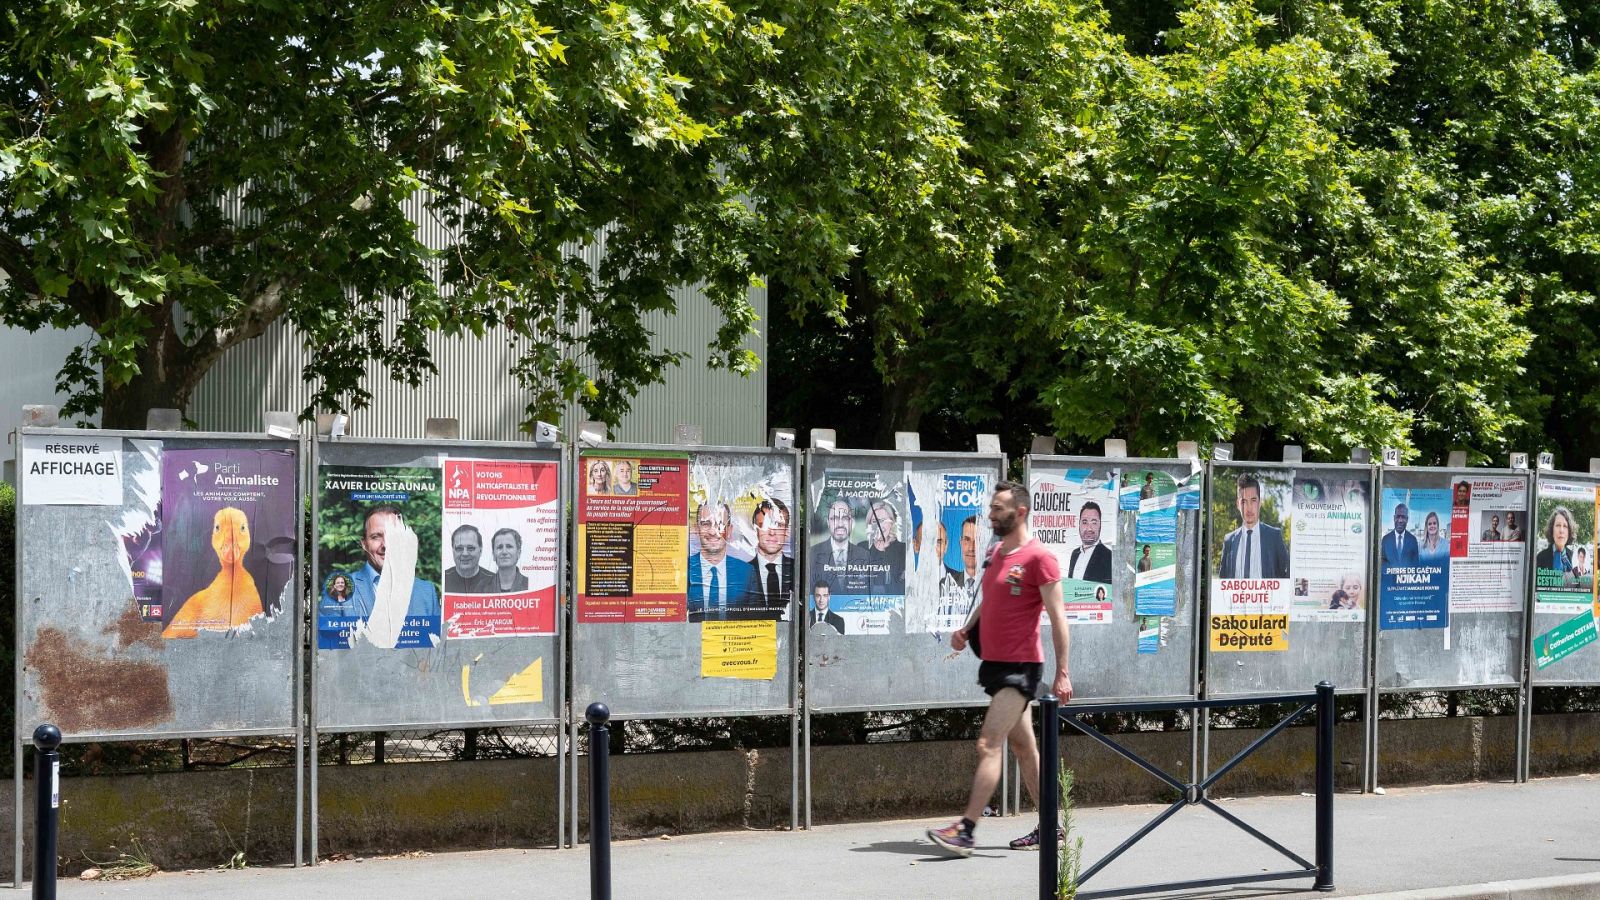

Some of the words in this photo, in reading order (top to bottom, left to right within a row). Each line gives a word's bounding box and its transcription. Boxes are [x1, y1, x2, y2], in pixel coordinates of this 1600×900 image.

[542, 427, 550, 436] 3
[46, 444, 100, 454] RÉSERVÉ
[1386, 451, 1396, 460] 12
[1515, 456, 1524, 464] 13
[1542, 456, 1550, 464] 14
[30, 462, 114, 476] AFFICHAGE
[214, 462, 240, 474] Parti
[215, 474, 279, 486] Animaliste
[325, 480, 363, 490] XAVIER
[366, 481, 436, 491] LOUSTAUNAU
[448, 488, 470, 499] NPA
[838, 488, 843, 497] À
[1034, 492, 1071, 511] GAUCHE
[1033, 514, 1076, 527] RÉPUBLICAINE
[1038, 529, 1066, 544] SOCIALE
[1416, 566, 1441, 574] GAÉTAN
[1396, 574, 1430, 584] NJIKAM
[1221, 581, 1280, 590] SABOULARD
[1232, 591, 1269, 603] DÉPUTÉ
[483, 598, 540, 610] LARROQUET
[1212, 616, 1286, 630] Saboulard
[1220, 632, 1272, 649] Député
[1550, 633, 1574, 650] Catherine
